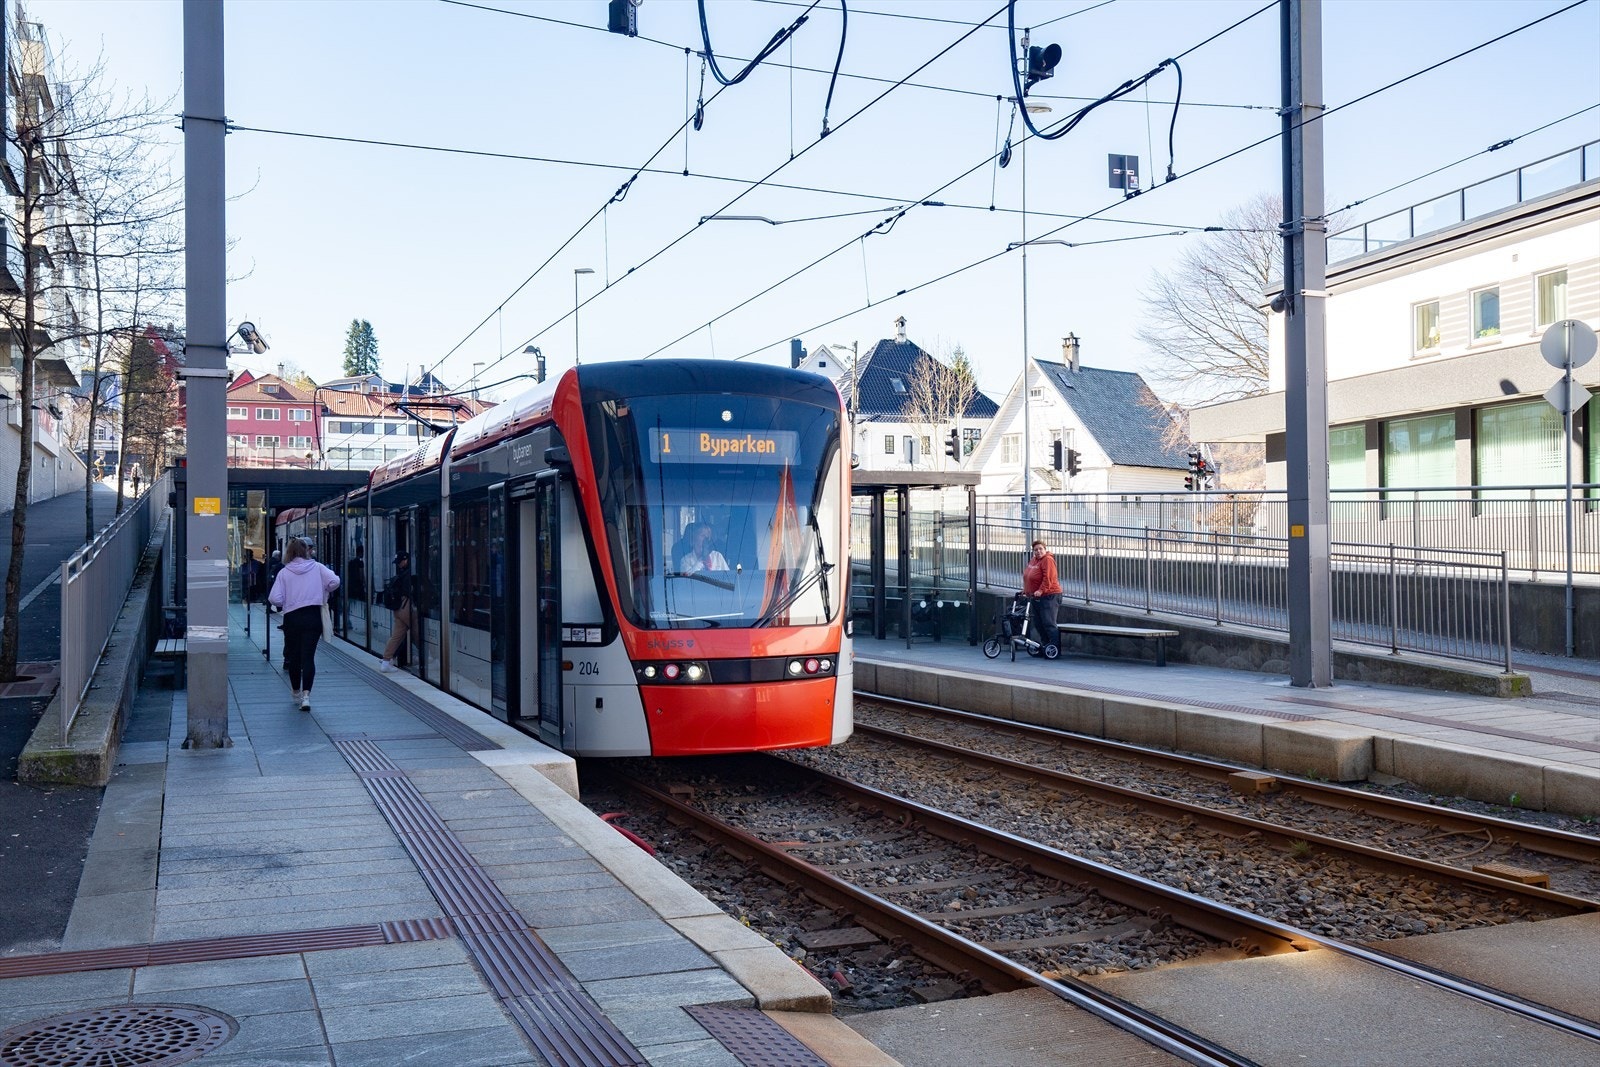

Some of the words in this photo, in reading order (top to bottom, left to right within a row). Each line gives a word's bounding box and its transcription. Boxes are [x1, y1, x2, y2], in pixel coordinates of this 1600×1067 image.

[663, 433, 671, 453] 1
[700, 433, 776, 457] Byparken
[647, 638, 684, 650] skyss
[579, 661, 599, 675] 204
